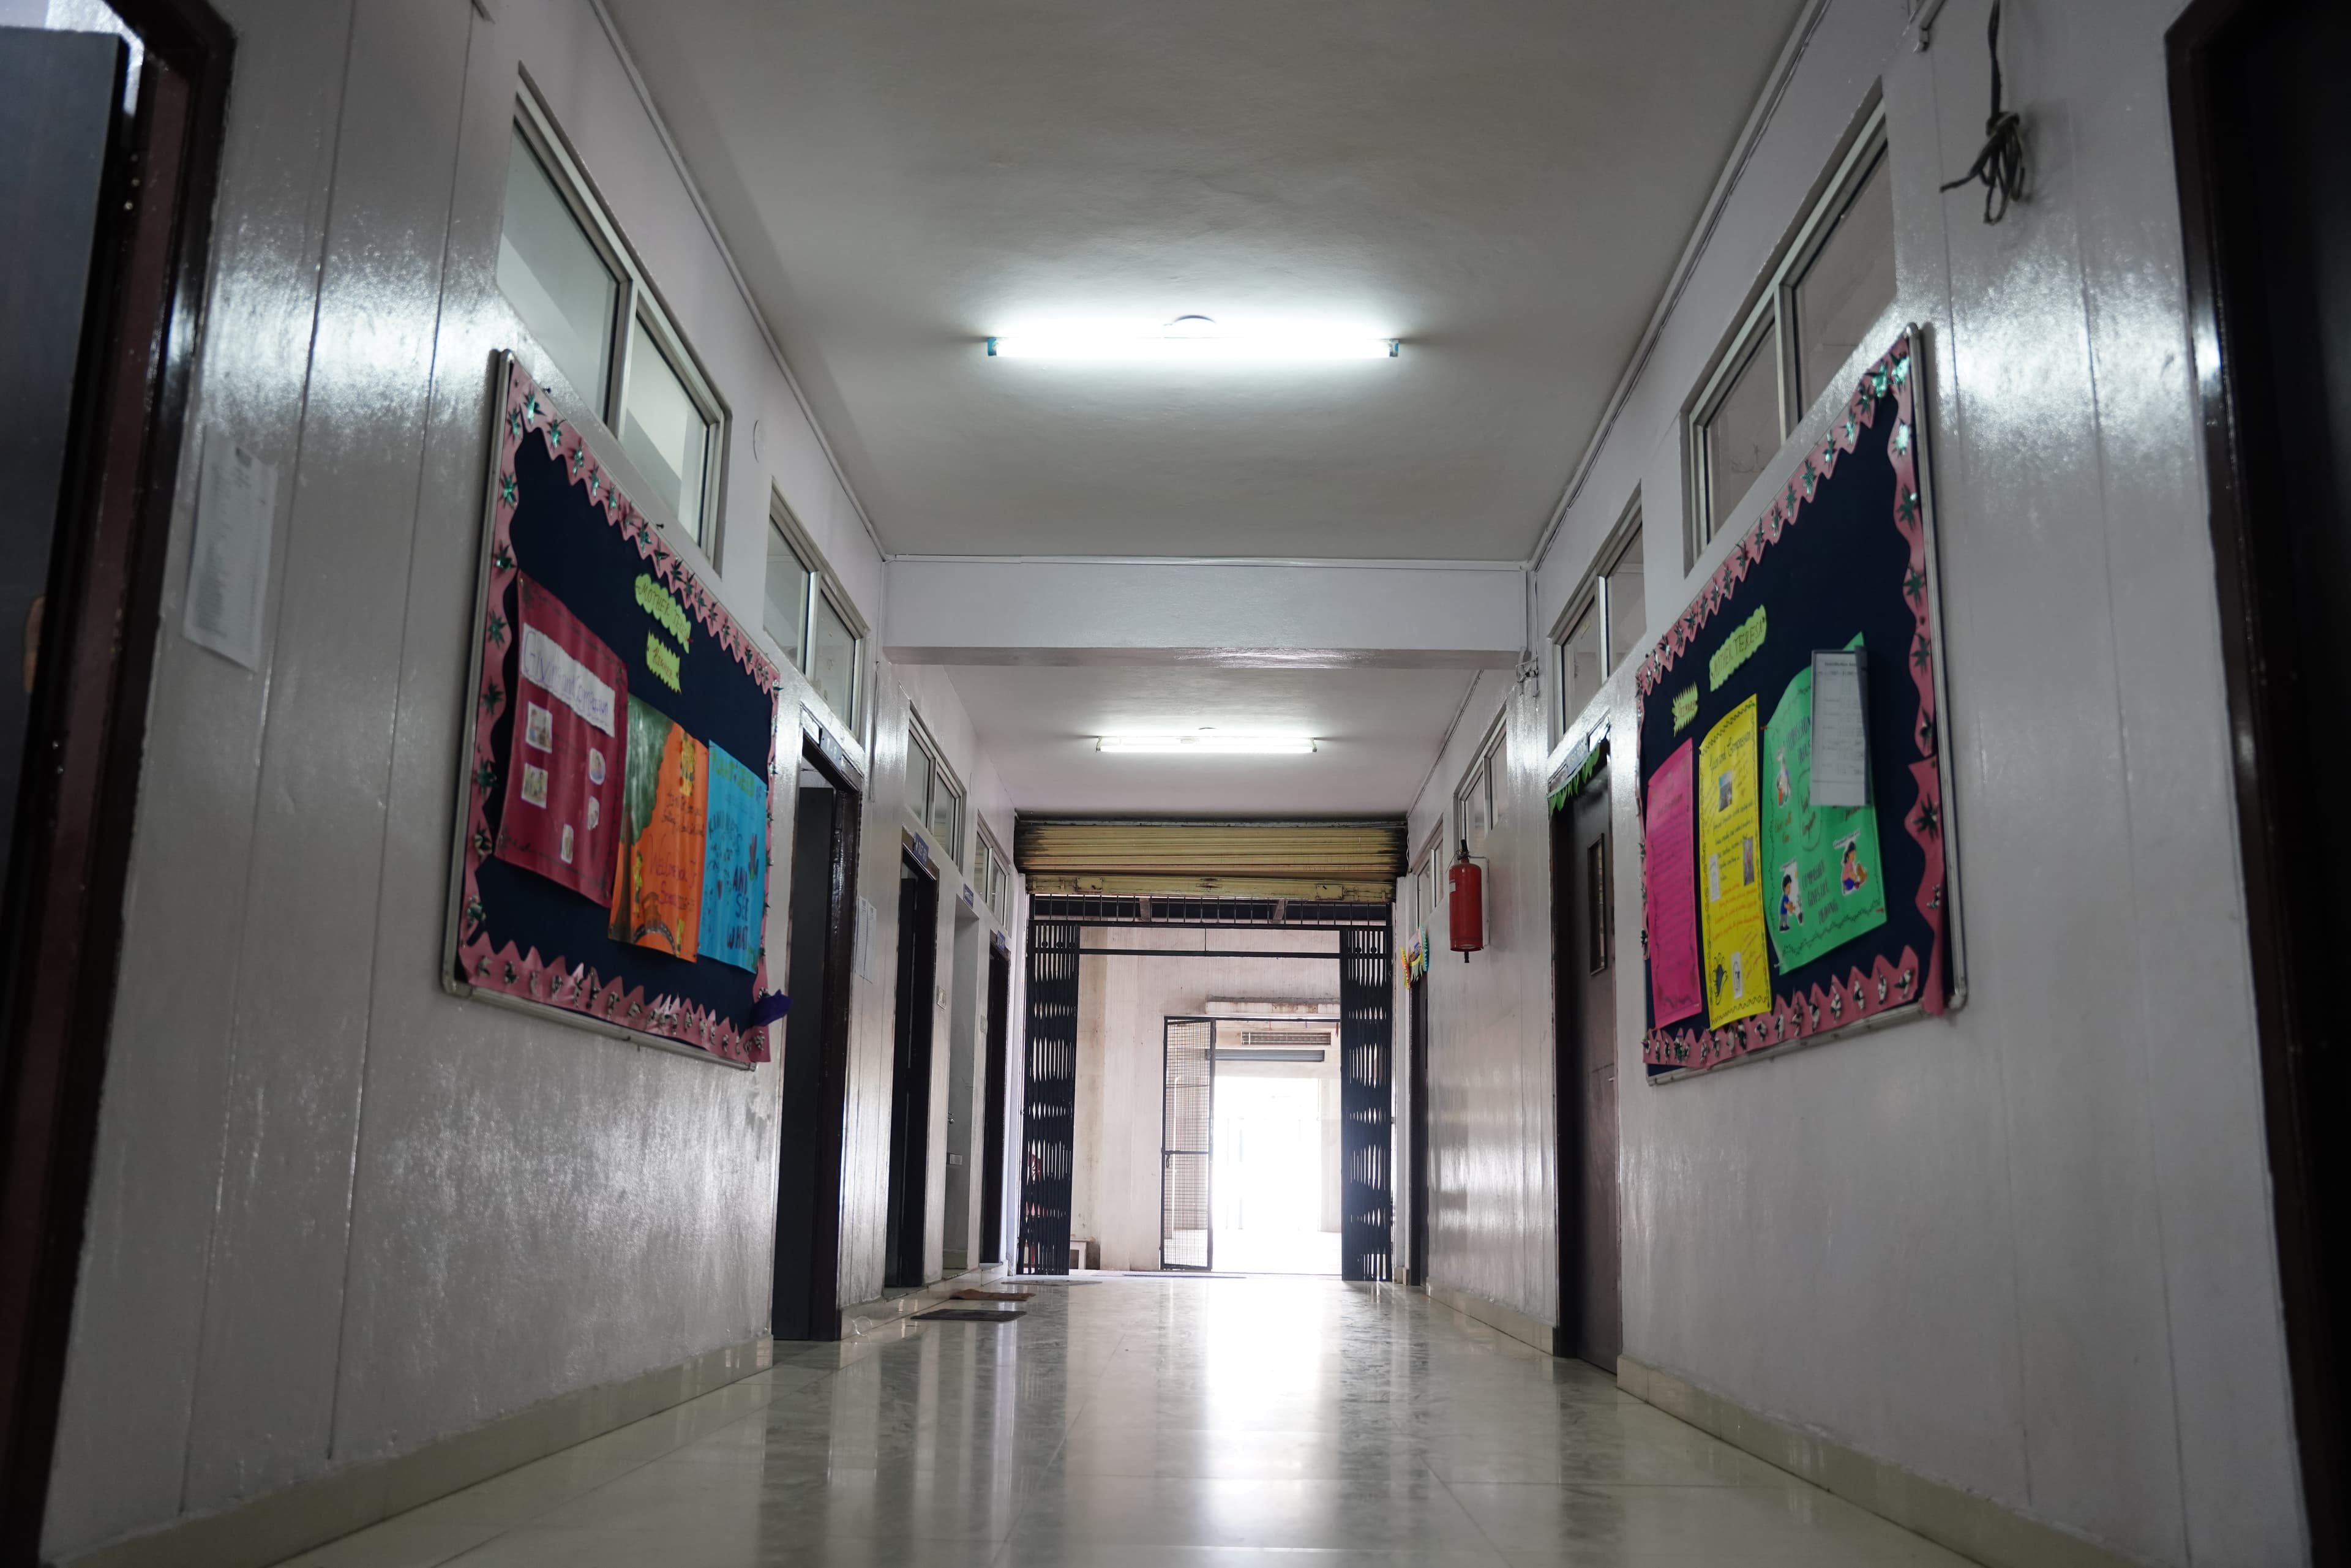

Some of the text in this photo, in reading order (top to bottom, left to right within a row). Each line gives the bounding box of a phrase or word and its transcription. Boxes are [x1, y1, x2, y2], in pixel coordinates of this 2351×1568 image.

[638, 582, 670, 617] MOTHER
[1714, 617, 1764, 677] MOTHER TERESA
[732, 865, 748, 895] AND
[735, 892, 749, 921] SEE
[726, 924, 749, 951] WHAT
